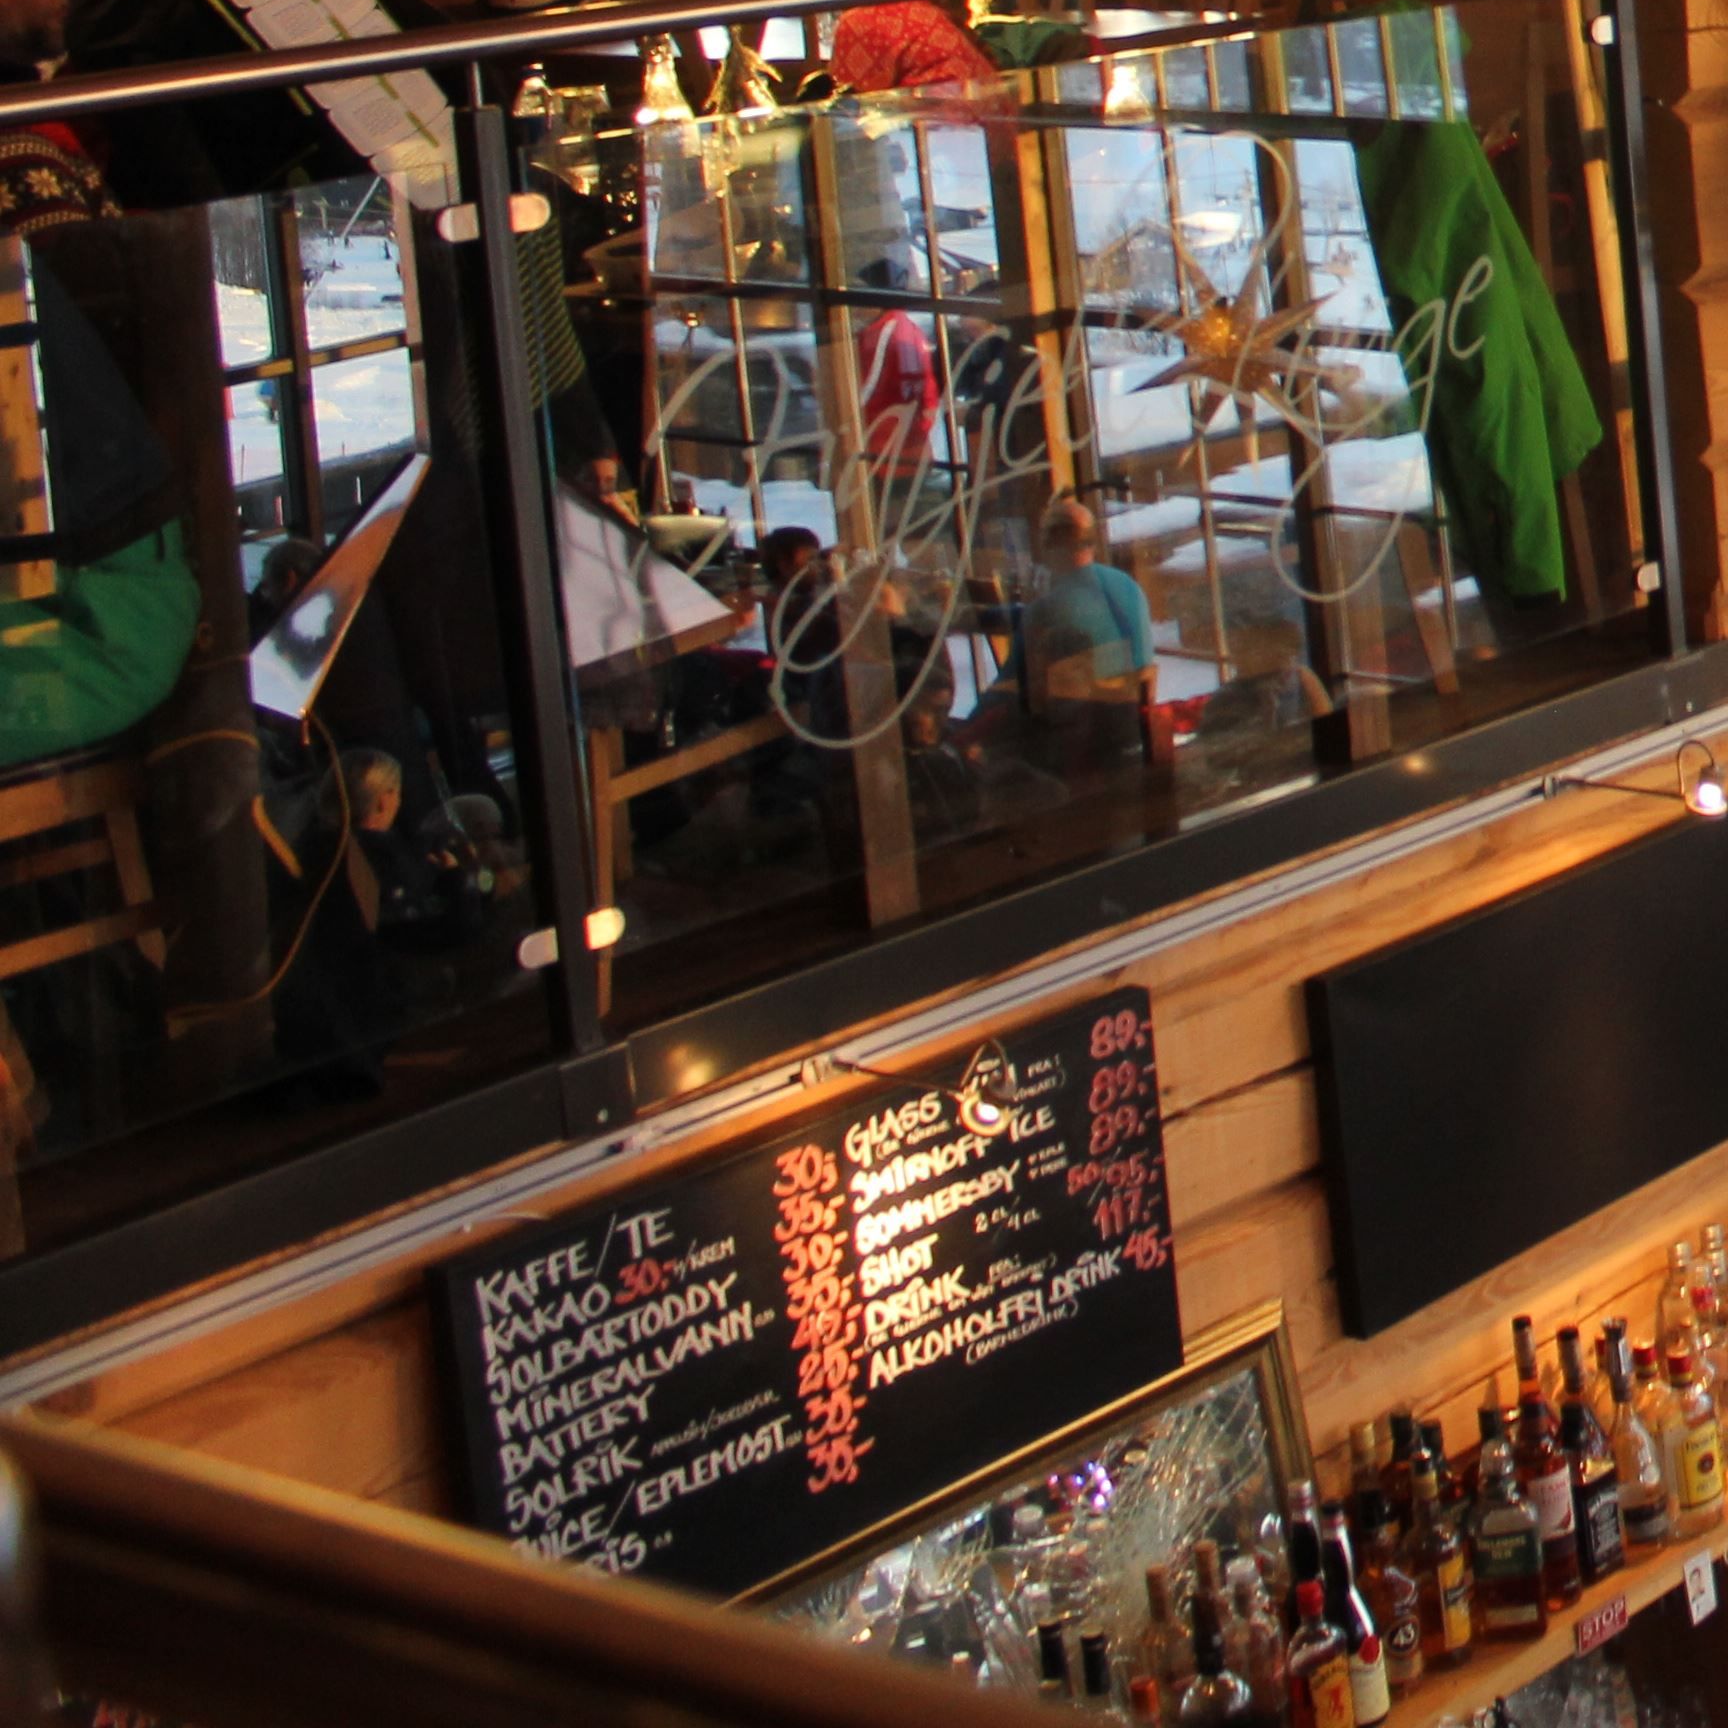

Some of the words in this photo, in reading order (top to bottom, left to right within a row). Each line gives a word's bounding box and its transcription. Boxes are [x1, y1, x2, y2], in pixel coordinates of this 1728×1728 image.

[845, 1091, 943, 1168] GLASS
[1009, 1104, 1056, 1144] ICE
[854, 1159, 1020, 1253] SOMMERSBY
[858, 1233, 940, 1298] SHOT
[864, 1264, 971, 1337] DRINK
[482, 1282, 612, 1362] KAKAO
[868, 1287, 1045, 1390] ALKOHOLFRI
[1048, 1245, 1124, 1304] DRINK
[496, 1301, 754, 1440] MINERALVANN
[499, 1382, 656, 1486] BATTERY
[505, 1435, 643, 1533] SOLRIK
[1581, 1598, 1625, 1641] STOP
